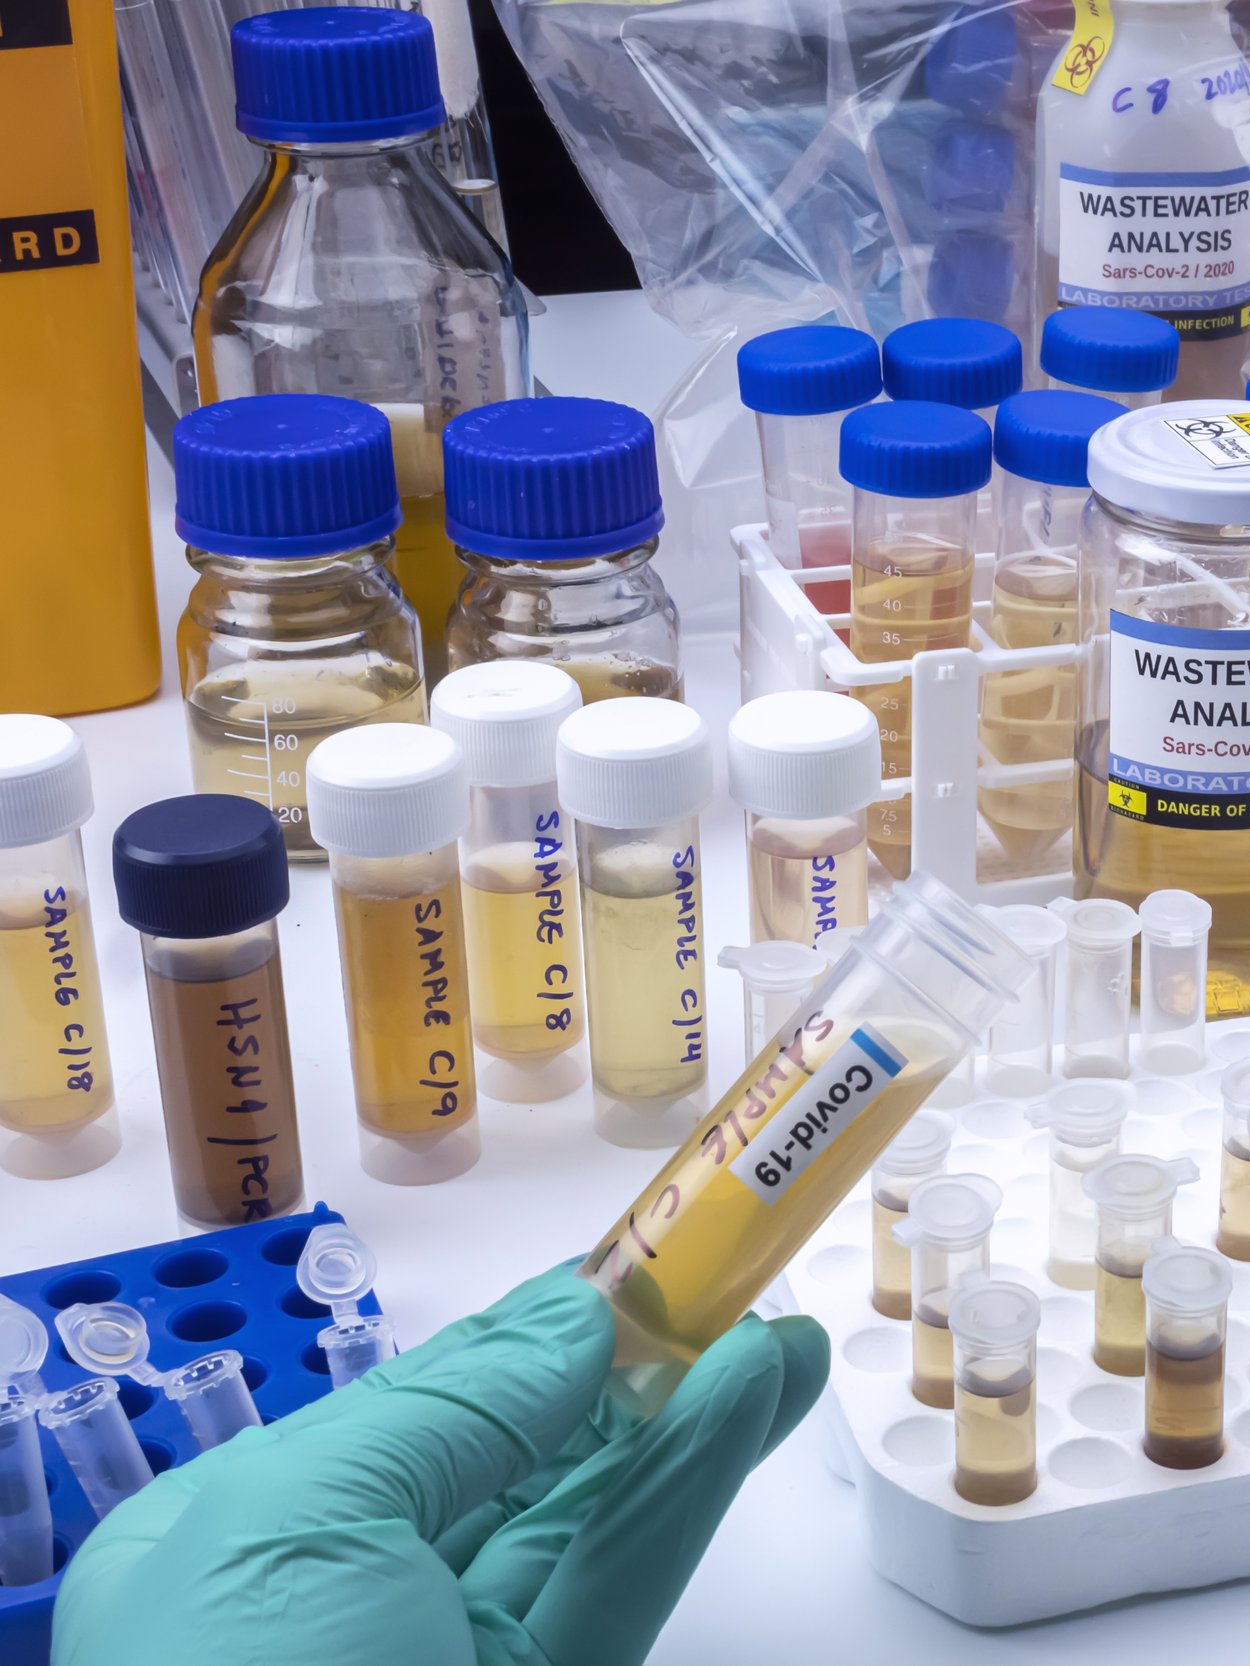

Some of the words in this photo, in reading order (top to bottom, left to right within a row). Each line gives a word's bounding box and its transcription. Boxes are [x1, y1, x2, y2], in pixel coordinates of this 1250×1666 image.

[1112, 87, 1134, 112] C
[1146, 78, 1170, 114] 8
[1080, 190, 1249, 217] WASTEWATER
[1107, 229, 1232, 253] ANALYSIS
[1102, 263, 1190, 279] Sars-Cov-2
[1193, 263, 1200, 279] /
[1204, 261, 1234, 278] 2020
[1061, 286, 1218, 308] LABORATORY
[1174, 315, 1234, 330] INFECTION
[883, 565, 903, 578] 45
[882, 599, 902, 613] 40
[882, 631, 901, 646] 35
[880, 696, 899, 711] 25
[274, 734, 299, 751] 60
[880, 729, 899, 743] 20
[276, 770, 300, 788] 40
[278, 807, 303, 823] 20
[1157, 799, 1221, 817] DANGER
[1226, 800, 1247, 817] OF
[882, 824, 892, 837] 5
[533, 810, 565, 945] SAMPLE
[672, 845, 698, 971] SAMPLE
[414, 898, 451, 1027] SAMPLE
[537, 964, 574, 1032] C/8
[671, 988, 703, 1063] C/14
[419, 1050, 460, 1117] C/9
[701, 1010, 834, 1165] SAMPLE
[754, 1064, 873, 1187] Covid-19
